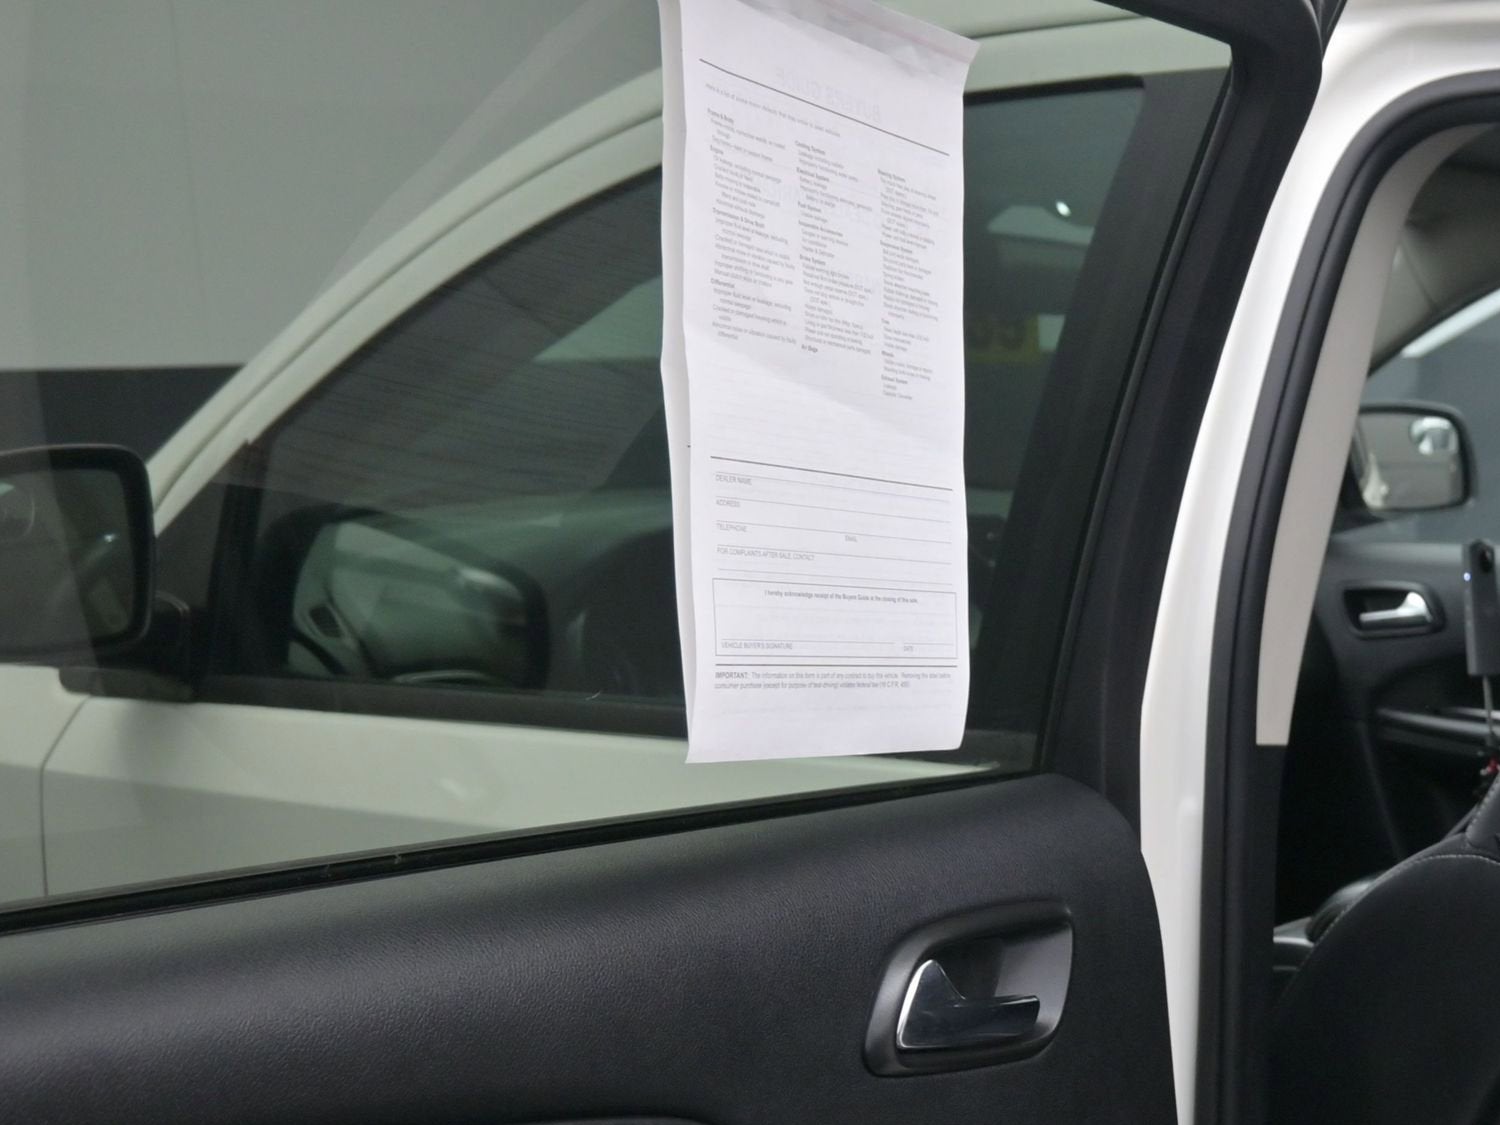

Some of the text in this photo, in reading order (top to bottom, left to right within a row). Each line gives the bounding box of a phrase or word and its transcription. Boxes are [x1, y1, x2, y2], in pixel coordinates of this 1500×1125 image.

[715, 474, 752, 486] DEALER NAME
[715, 499, 741, 508] ADDRESS
[716, 522, 748, 533] TELEPHONE
[717, 547, 728, 555] FOR
